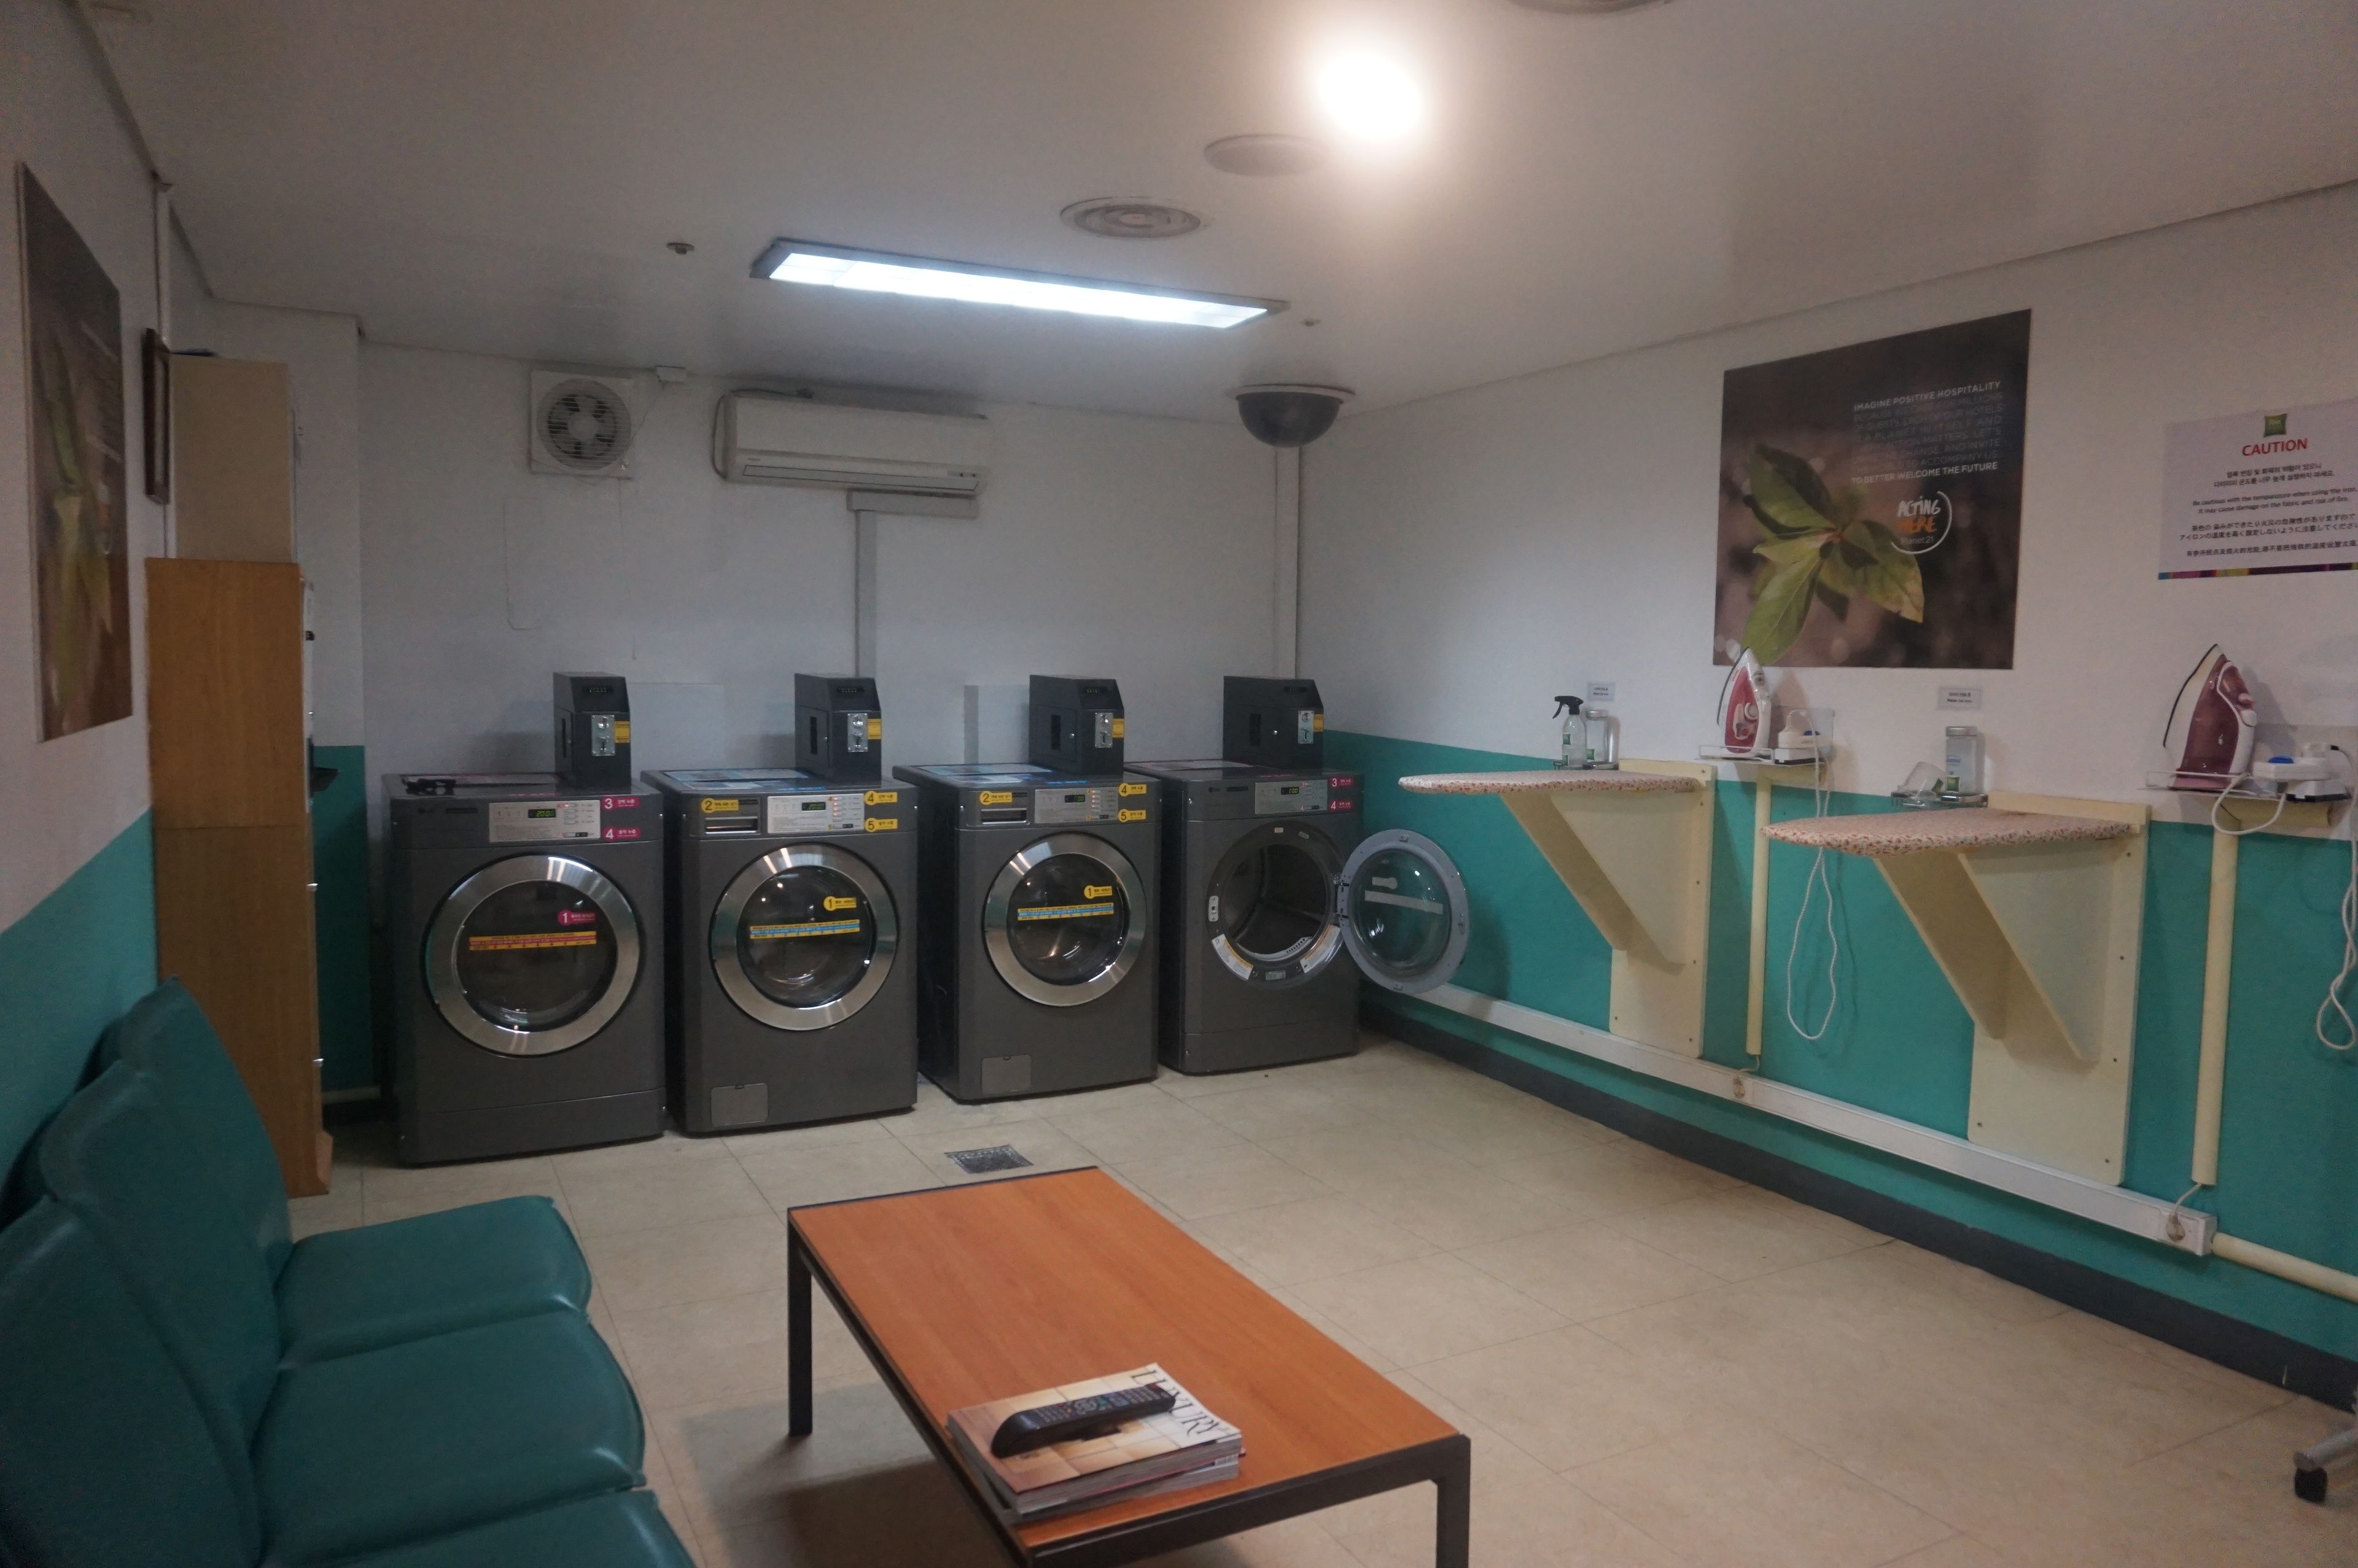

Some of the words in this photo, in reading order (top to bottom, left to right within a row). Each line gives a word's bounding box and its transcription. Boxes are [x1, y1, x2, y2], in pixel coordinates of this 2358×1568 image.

[1854, 398, 1891, 411] IMAGINE
[1893, 392, 1935, 405] POSITIVE
[1938, 381, 2000, 398] HOSPITALITY
[2242, 438, 2308, 456] CAUTION
[1851, 476, 1862, 484] TO
[1864, 472, 1895, 484] BETTER
[1897, 467, 1940, 482] WELCOME
[1943, 465, 1959, 475] THE
[1962, 460, 1998, 473] FUTURE
[1897, 495, 1942, 517] ACTING
[1332, 778, 1337, 787] 3
[1121, 785, 1127, 794] 4
[868, 793, 874, 802] 4
[982, 793, 989, 802] 2
[605, 798, 613, 809] 3
[705, 800, 712, 810] 2
[1331, 801, 1336, 809] 4
[1121, 812, 1127, 820] 5
[868, 820, 874, 830] 5
[605, 828, 614, 839] 4
[1089, 888, 1092, 897] 1
[828, 899, 833, 909] 1
[563, 912, 567, 923] 1
